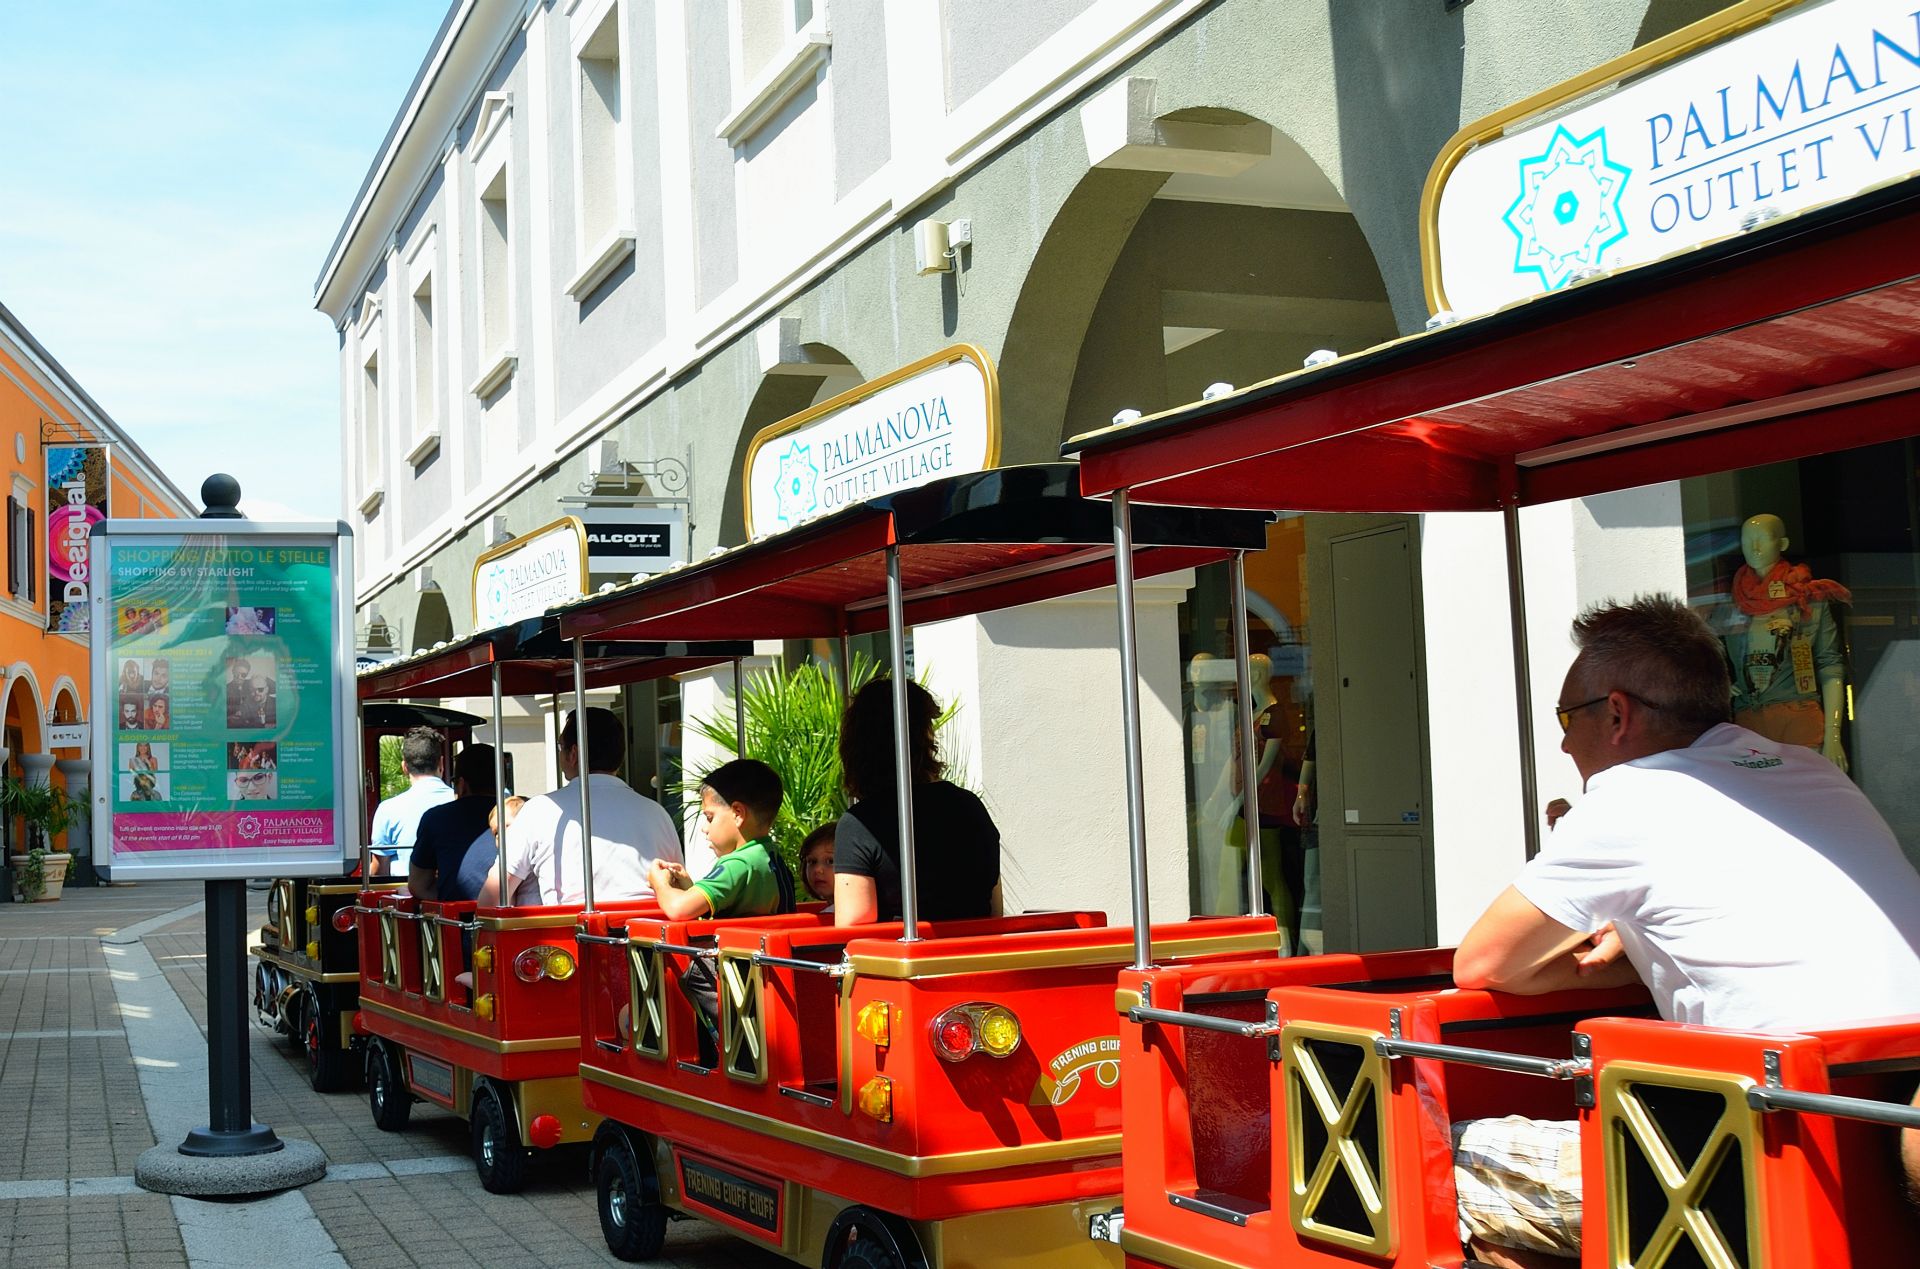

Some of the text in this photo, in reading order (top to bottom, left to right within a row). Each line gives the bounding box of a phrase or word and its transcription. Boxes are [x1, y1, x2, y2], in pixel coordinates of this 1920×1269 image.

[1650, 135, 1834, 233] OUTLET
[823, 396, 952, 473] PALMANOVA
[824, 443, 953, 508] OUTLET VILLAGE
[62, 481, 92, 603] Desigual
[118, 550, 325, 563] SHOPPING SOTTO LE STELLE
[587, 534, 661, 543] ALCOTT
[118, 568, 254, 577] SHOPPING BY STARLIGHT
[510, 549, 567, 589] PALMANOVA
[263, 817, 323, 826] PALMANOVA
